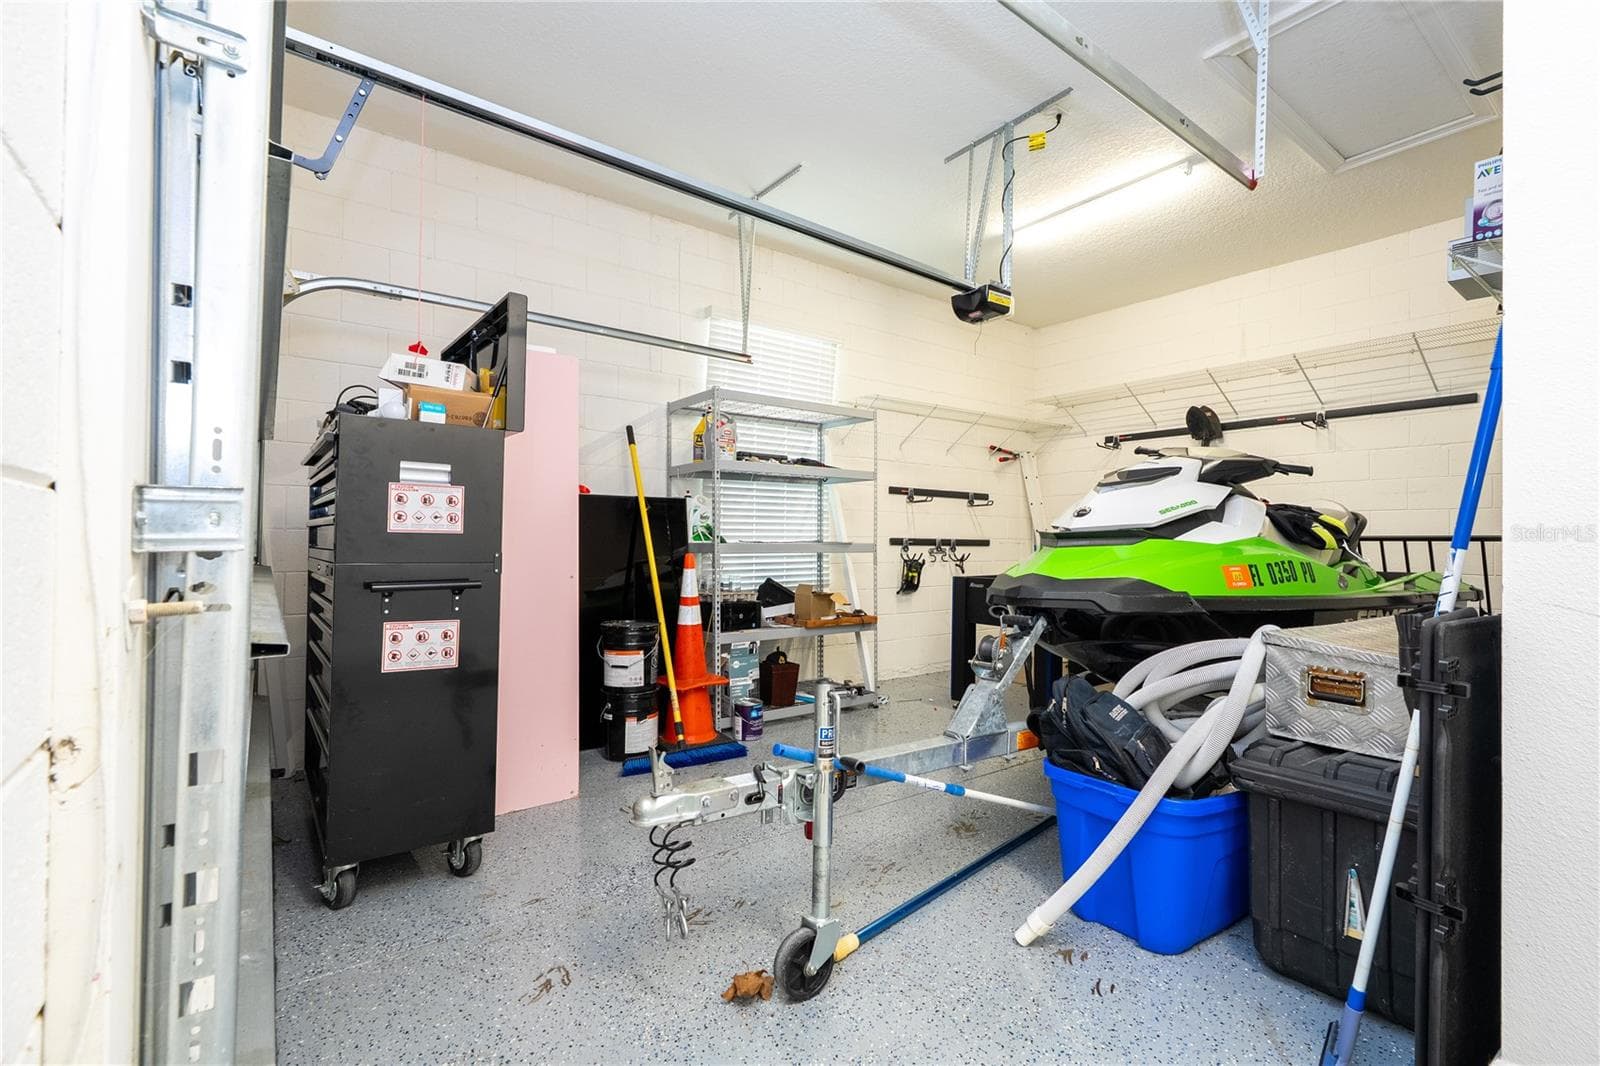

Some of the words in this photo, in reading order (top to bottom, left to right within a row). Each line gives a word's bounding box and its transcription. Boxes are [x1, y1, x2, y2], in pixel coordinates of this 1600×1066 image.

[1247, 563, 1265, 587] FL
[1266, 559, 1298, 585] 0350
[1300, 561, 1316, 584] PU
[821, 728, 834, 739] PR
